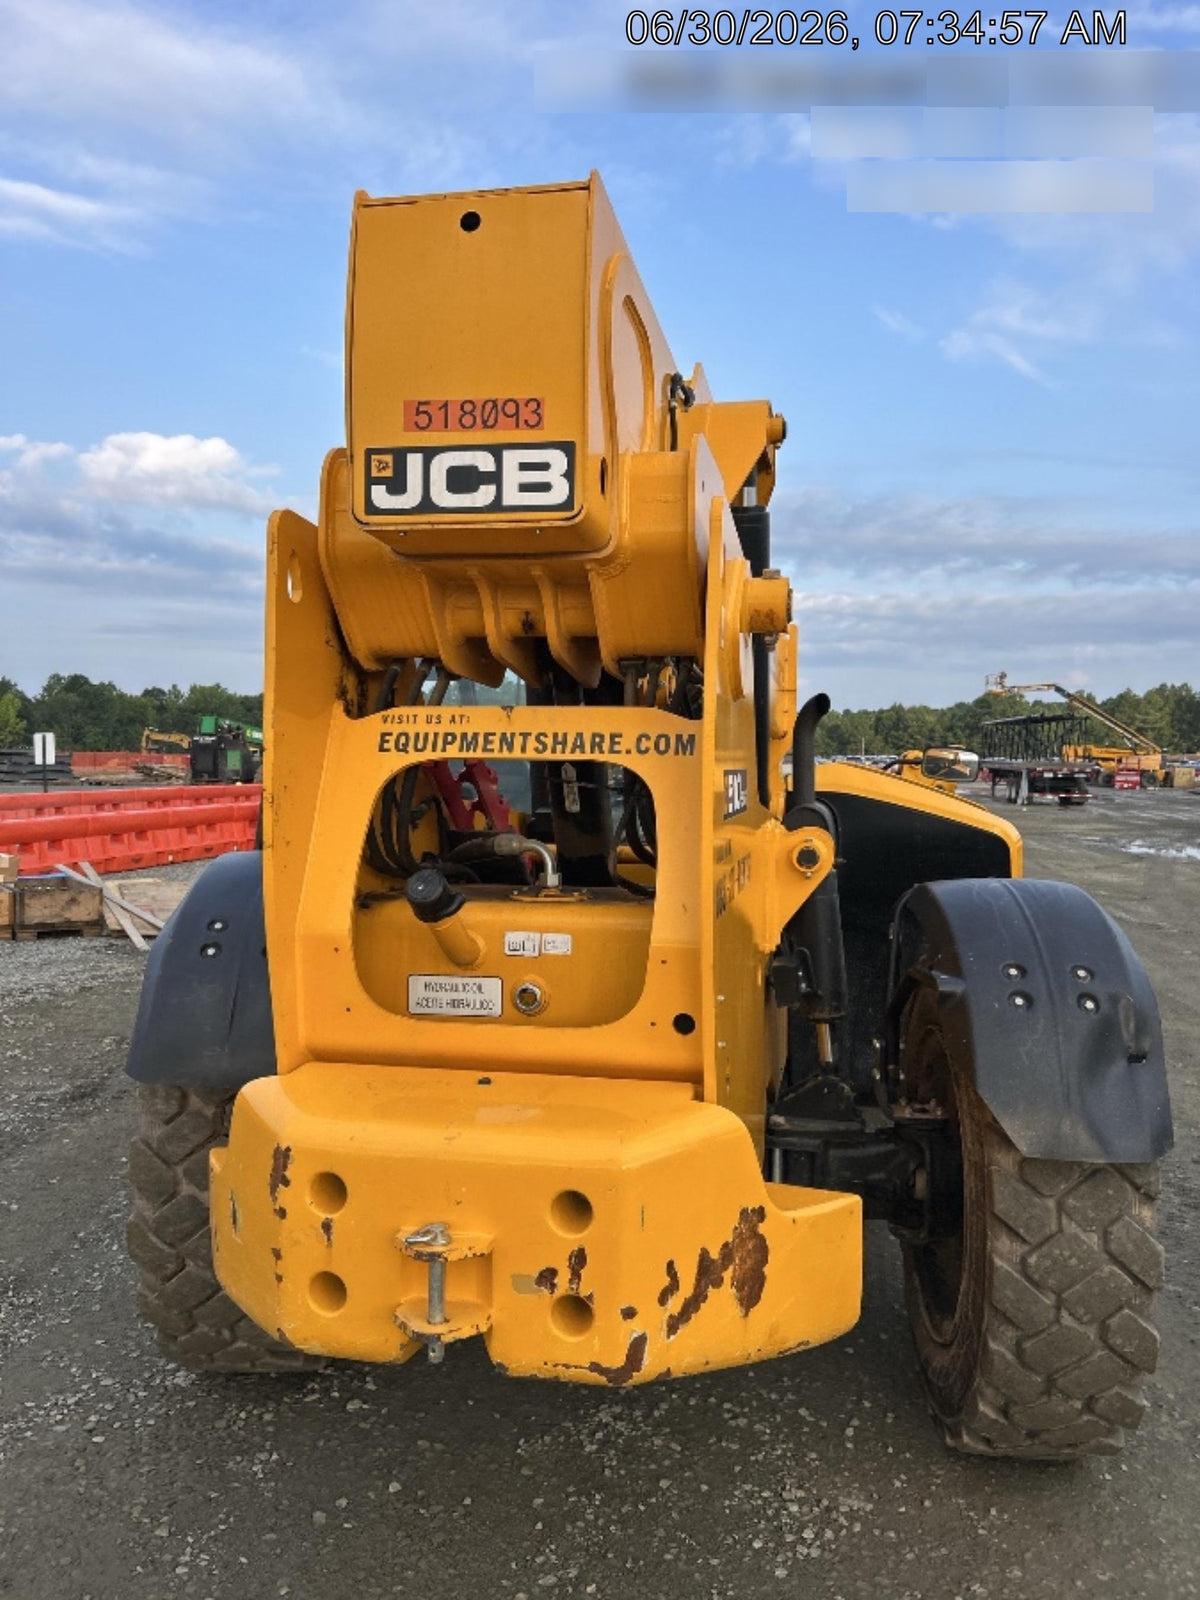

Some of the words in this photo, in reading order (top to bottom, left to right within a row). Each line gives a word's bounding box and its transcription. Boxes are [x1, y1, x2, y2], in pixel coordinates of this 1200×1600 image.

[413, 398, 543, 431] 518093
[370, 449, 570, 510] JCB
[381, 714, 418, 724] VISIT
[426, 714, 442, 724] US
[449, 714, 470, 724] AT:
[378, 731, 696, 756] EQUIPMENTSHARE.COM
